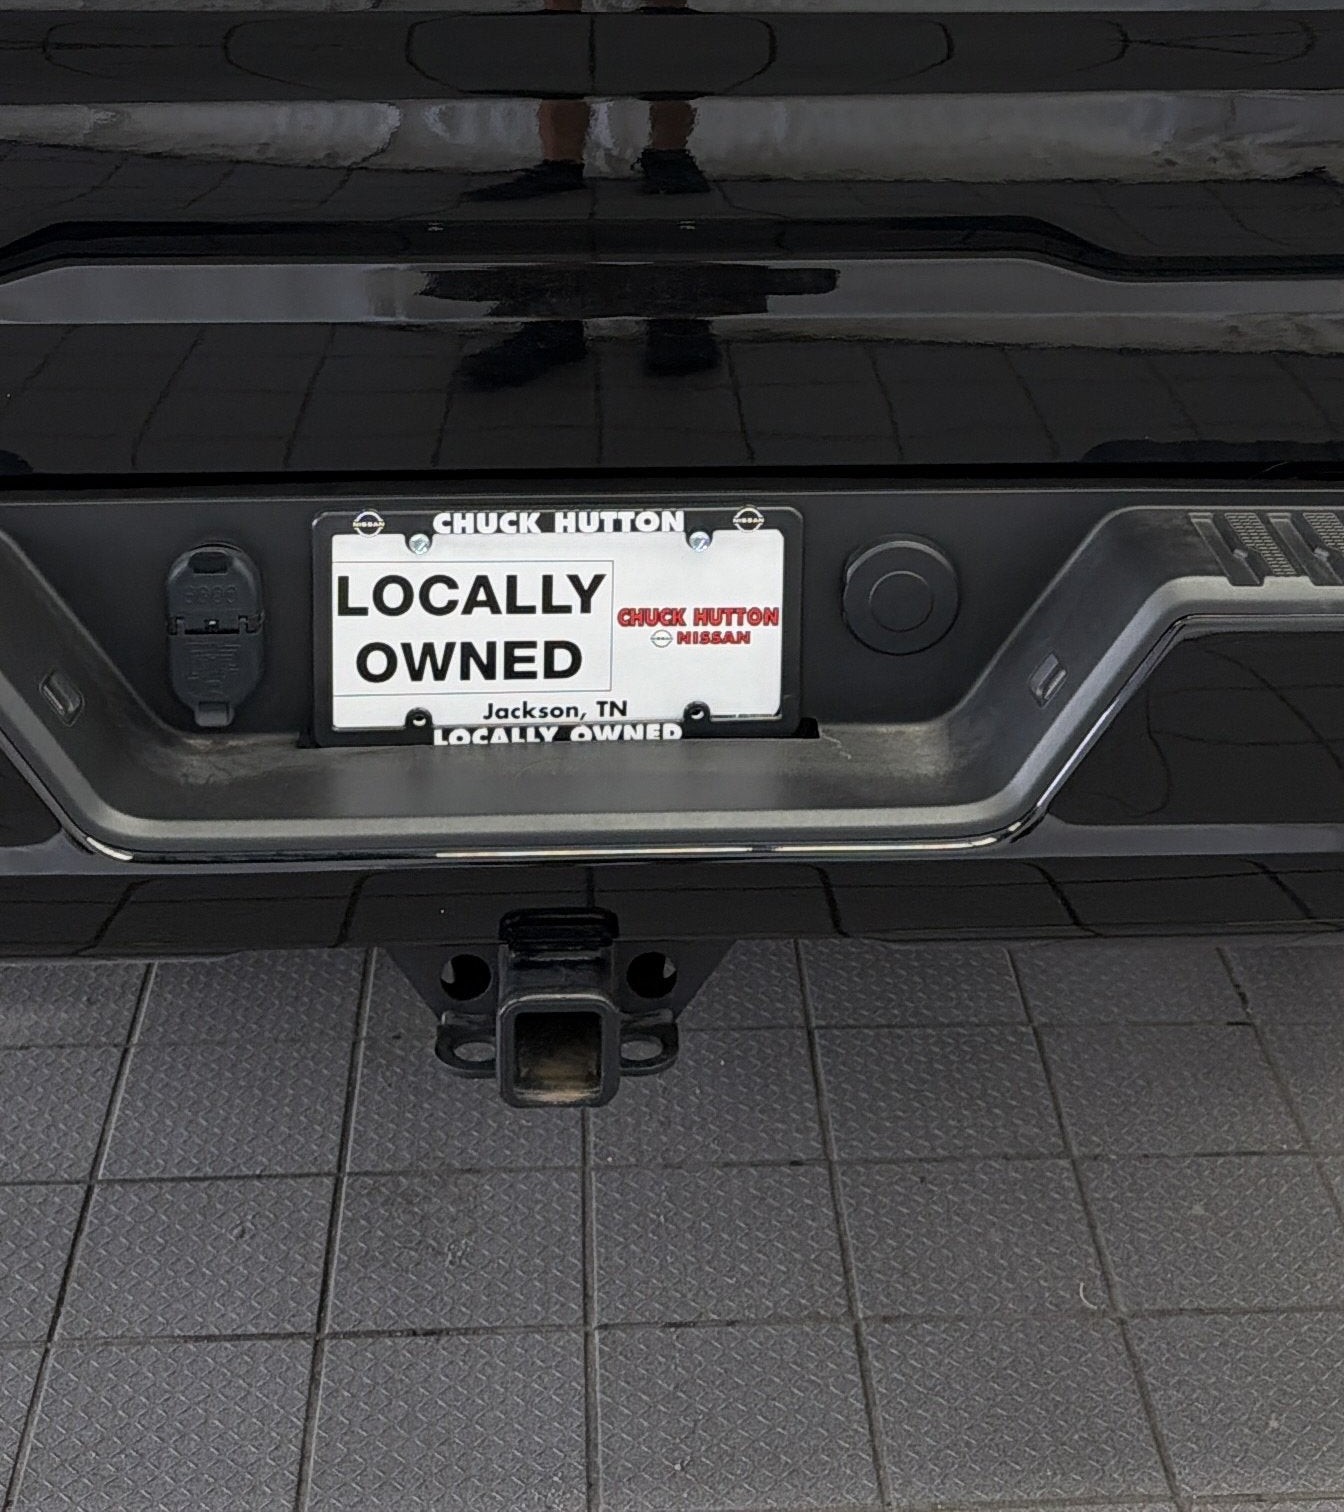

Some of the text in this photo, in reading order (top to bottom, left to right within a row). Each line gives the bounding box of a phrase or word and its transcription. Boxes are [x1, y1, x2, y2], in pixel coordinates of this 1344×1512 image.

[432, 510, 685, 534] CHUCK HUTTON
[337, 573, 607, 617] LOCALLY
[617, 606, 780, 627] CHUCK HUTTON
[676, 630, 751, 645] NISSAN
[356, 639, 583, 683] OWNED
[483, 700, 628, 720] Jackson, TN
[433, 722, 683, 746] LOCALLY OWNED
